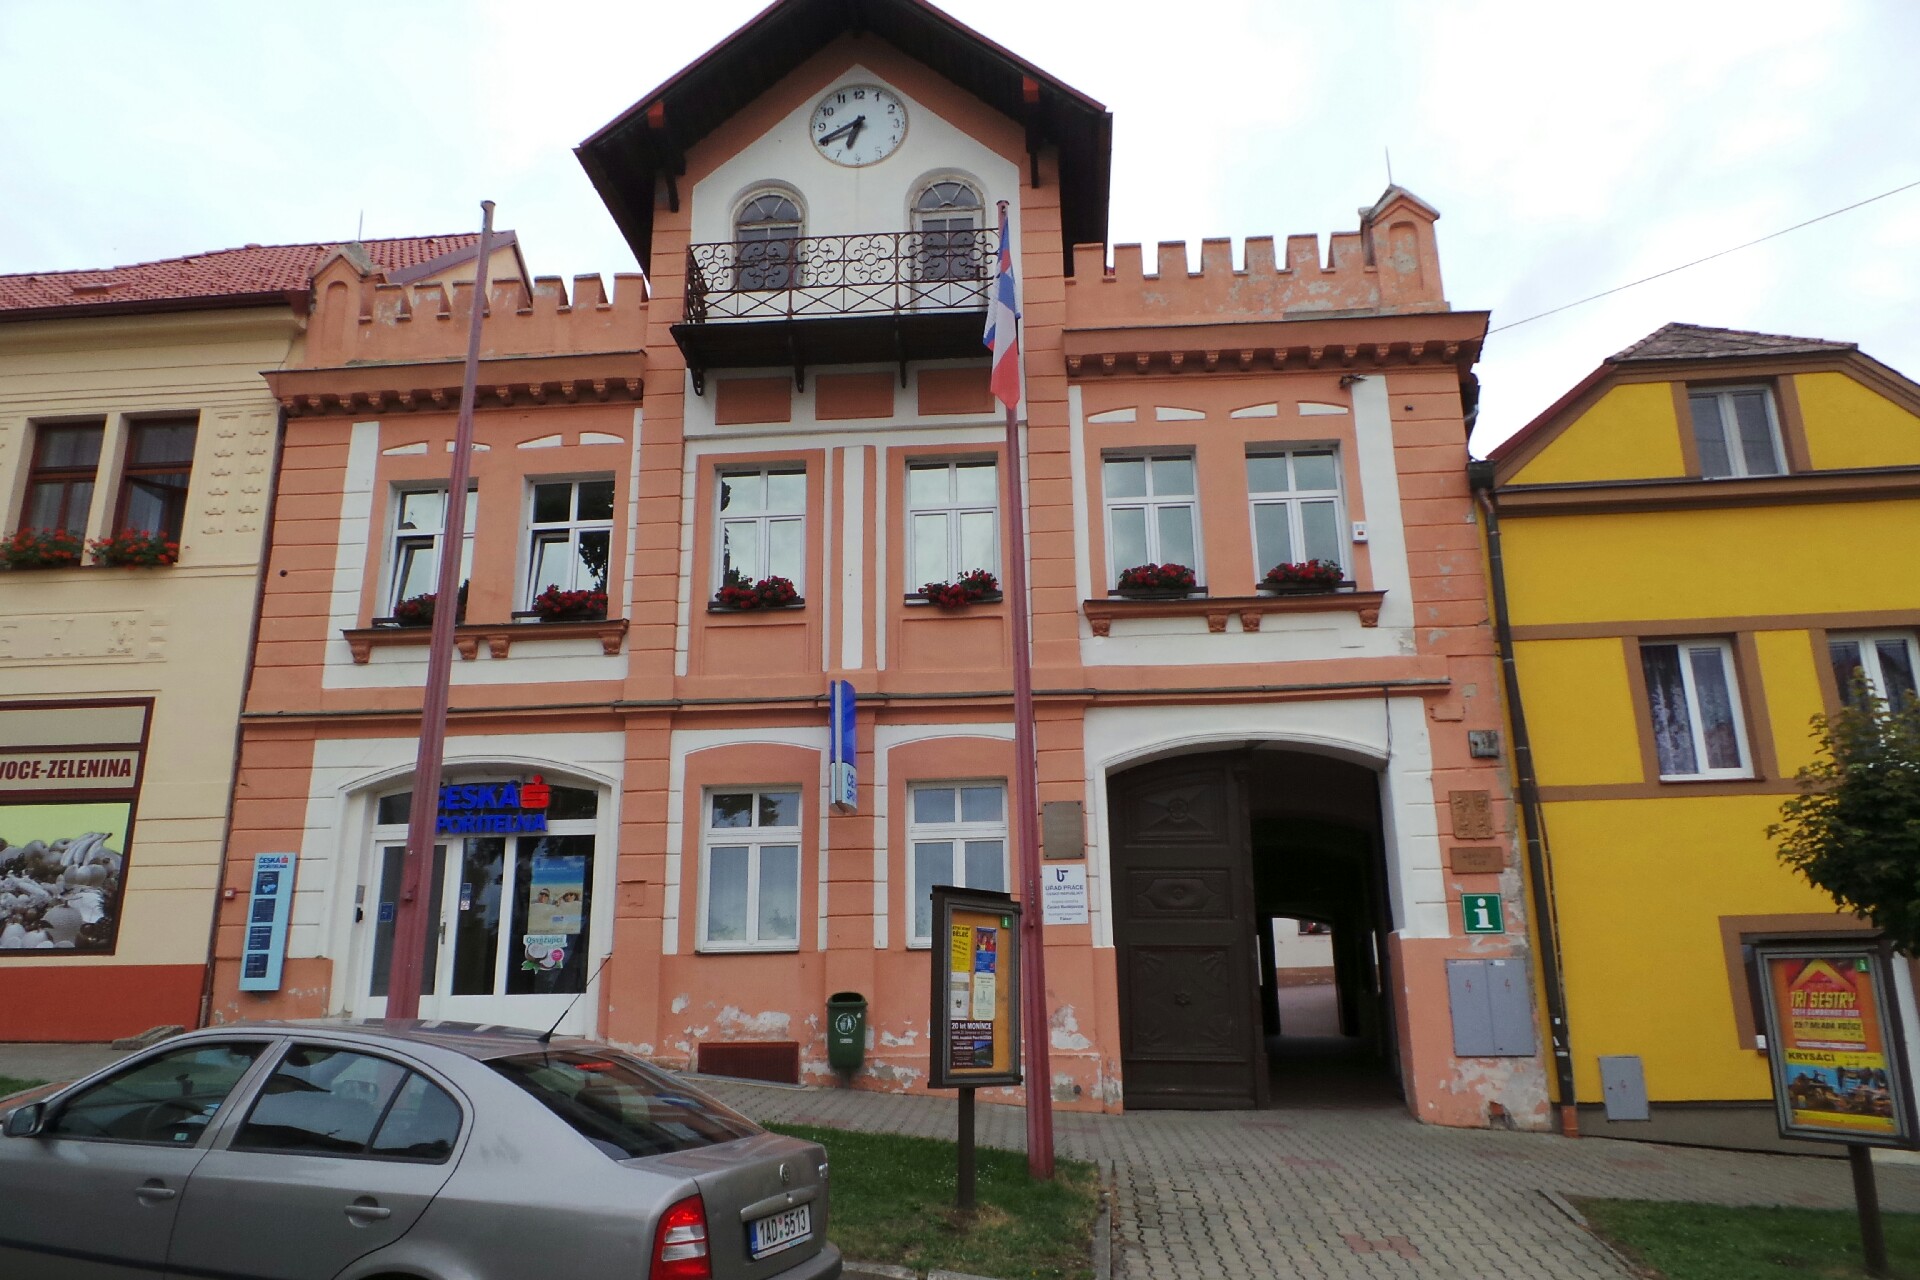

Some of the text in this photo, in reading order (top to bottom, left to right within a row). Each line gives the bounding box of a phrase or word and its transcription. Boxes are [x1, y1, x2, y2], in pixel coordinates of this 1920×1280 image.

[837, 94, 846, 103] 11
[854, 90, 865, 99] 12
[875, 92, 880, 102] 1
[823, 107, 834, 116] 10
[887, 104, 895, 114] 2
[818, 122, 826, 131] 9
[893, 118, 900, 128] 3
[835, 149, 842, 158] 7
[435, 811, 547, 833] POŘITELNA
[1811, 992, 1855, 1008] SESTRY
[951, 1022, 959, 1030] 20
[760, 1209, 806, 1246] 1AD 5513
